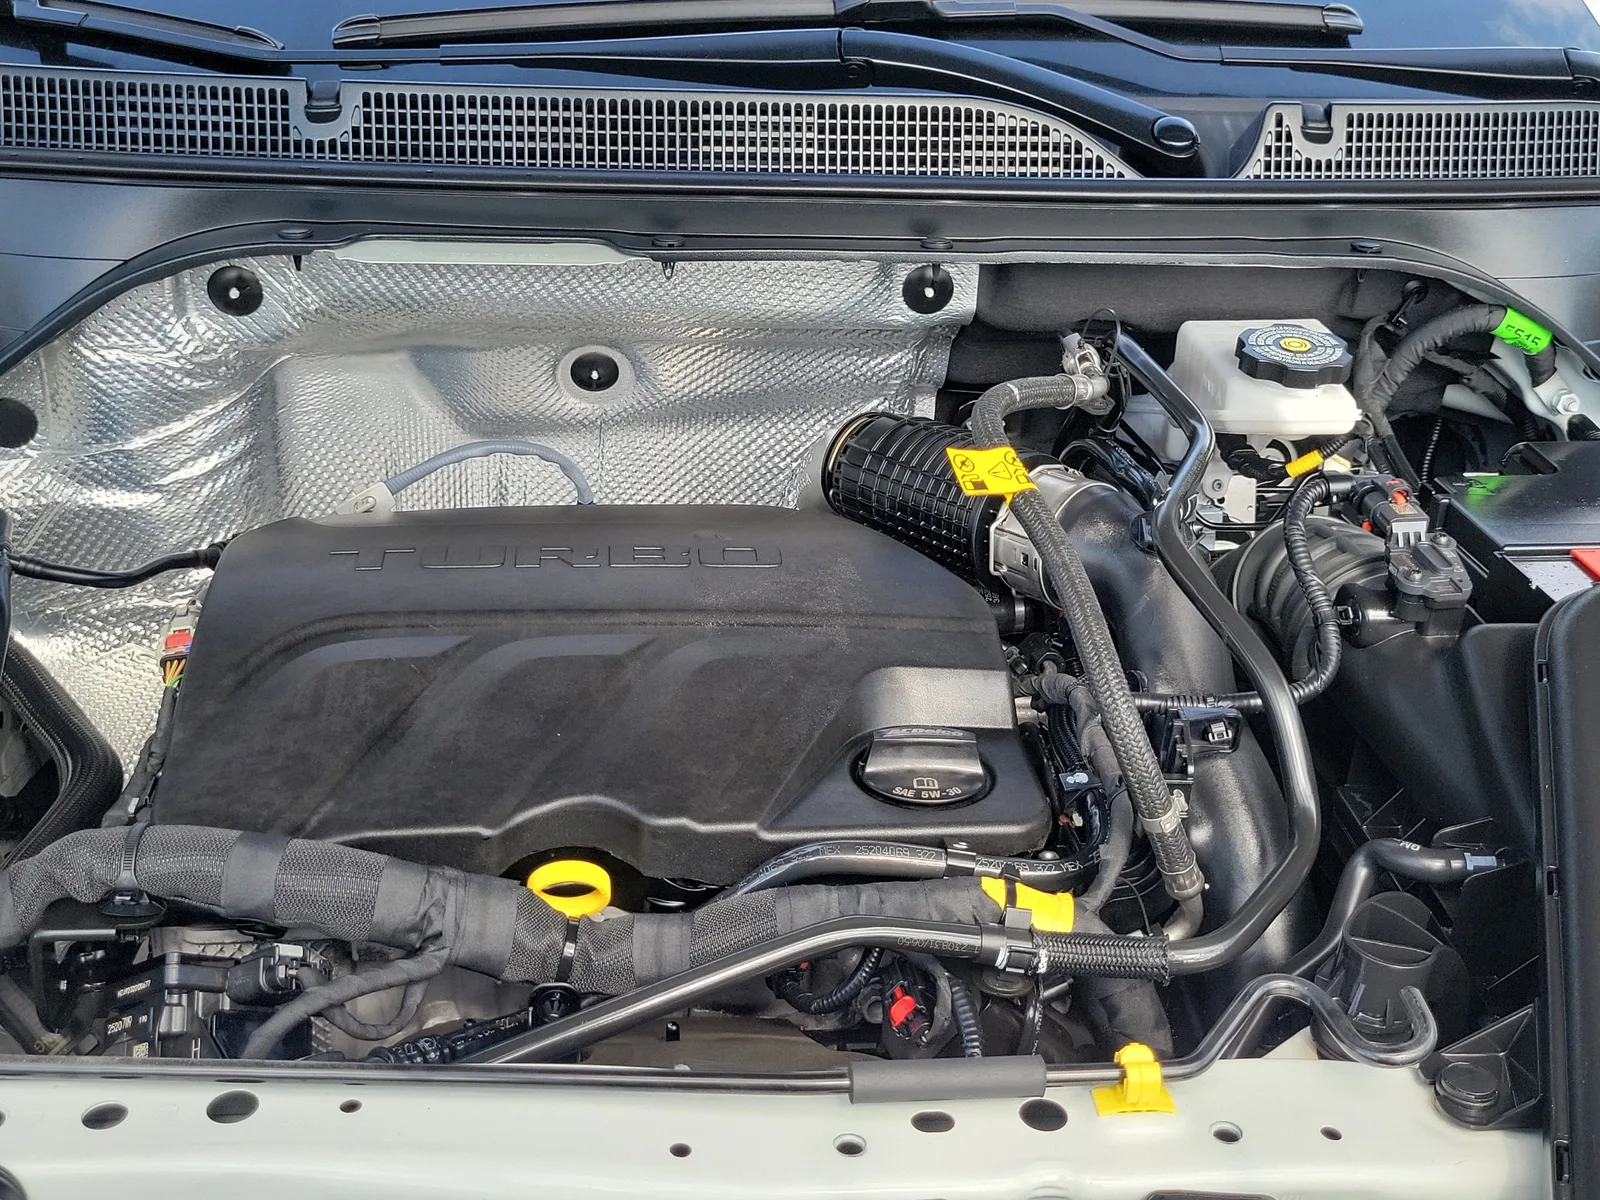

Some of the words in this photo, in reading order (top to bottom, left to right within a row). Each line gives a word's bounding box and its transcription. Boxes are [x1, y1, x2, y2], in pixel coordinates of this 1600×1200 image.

[329, 544, 783, 570] TURBO
[892, 787, 916, 798] SAE
[921, 787, 962, 798] 5W-30
